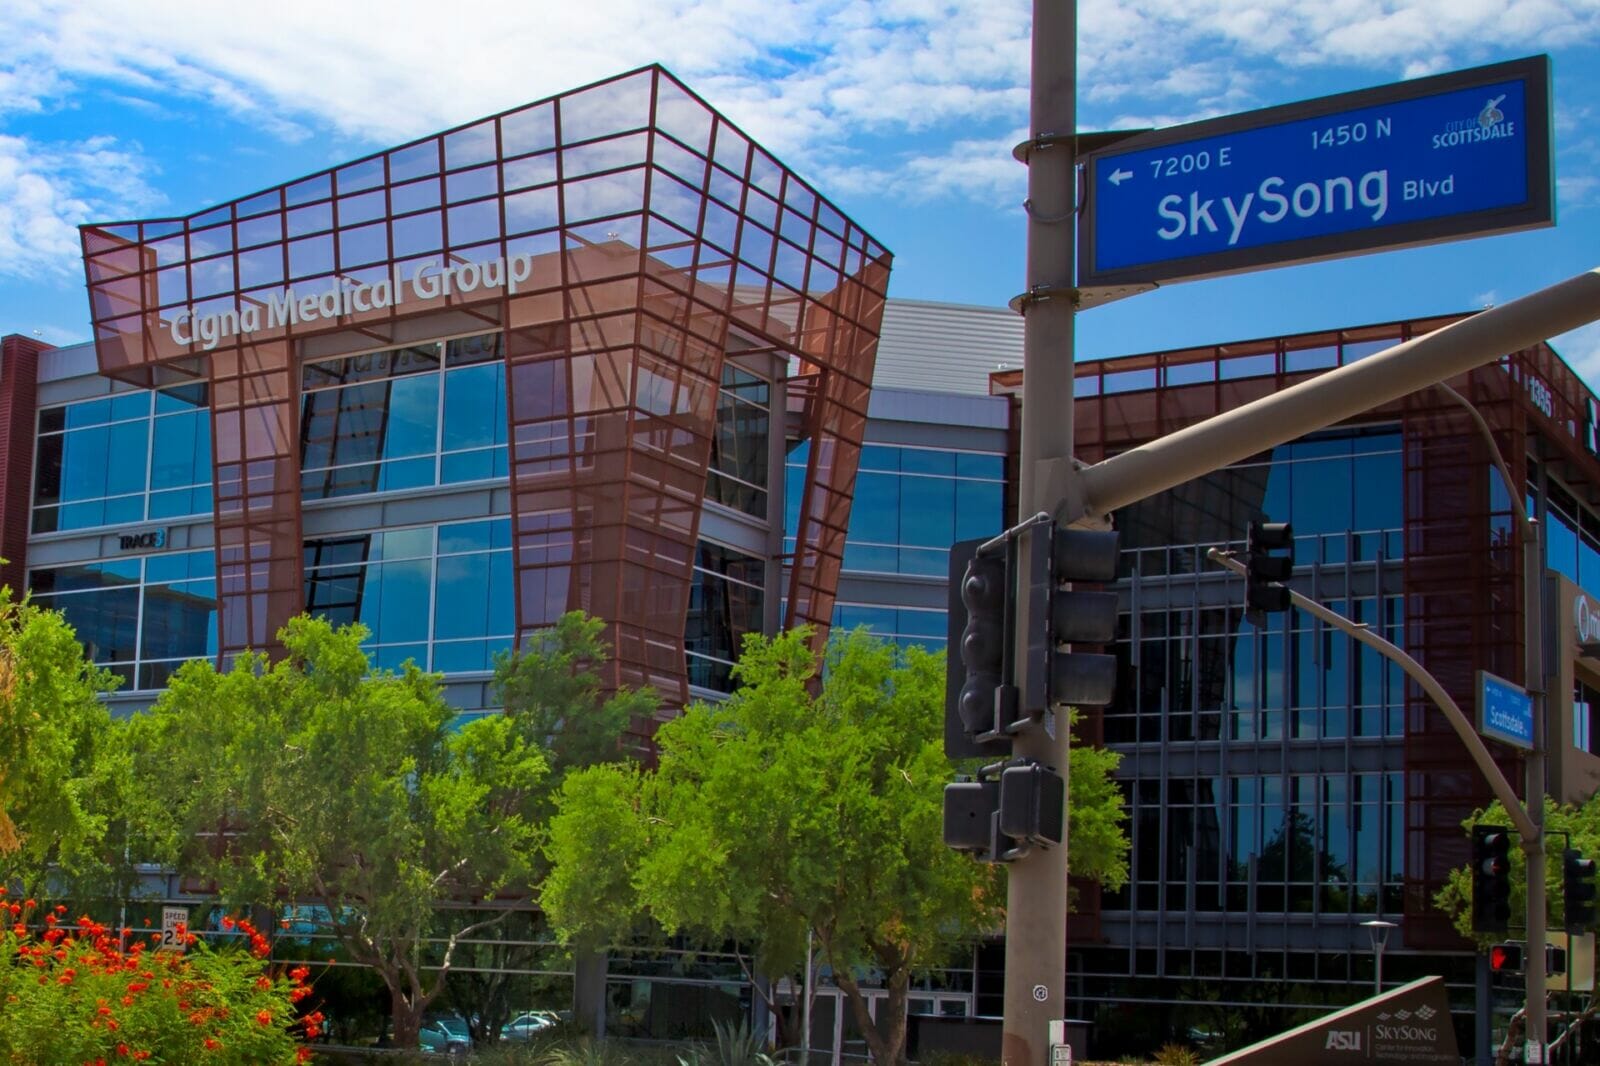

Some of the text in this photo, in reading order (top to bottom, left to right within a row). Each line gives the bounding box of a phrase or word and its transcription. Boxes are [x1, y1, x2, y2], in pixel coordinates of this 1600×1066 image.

[1311, 117, 1392, 150] 1450 N
[1432, 122, 1515, 149] SCOTTSDALE
[1446, 119, 1464, 132] CITY
[1150, 148, 1232, 178] 7200 E
[1156, 169, 1454, 245] SkySong Blvd
[170, 252, 532, 350] Cigna Medical Group
[165, 912, 186, 920] SPEED
[1325, 1031, 1361, 1050] ASU
